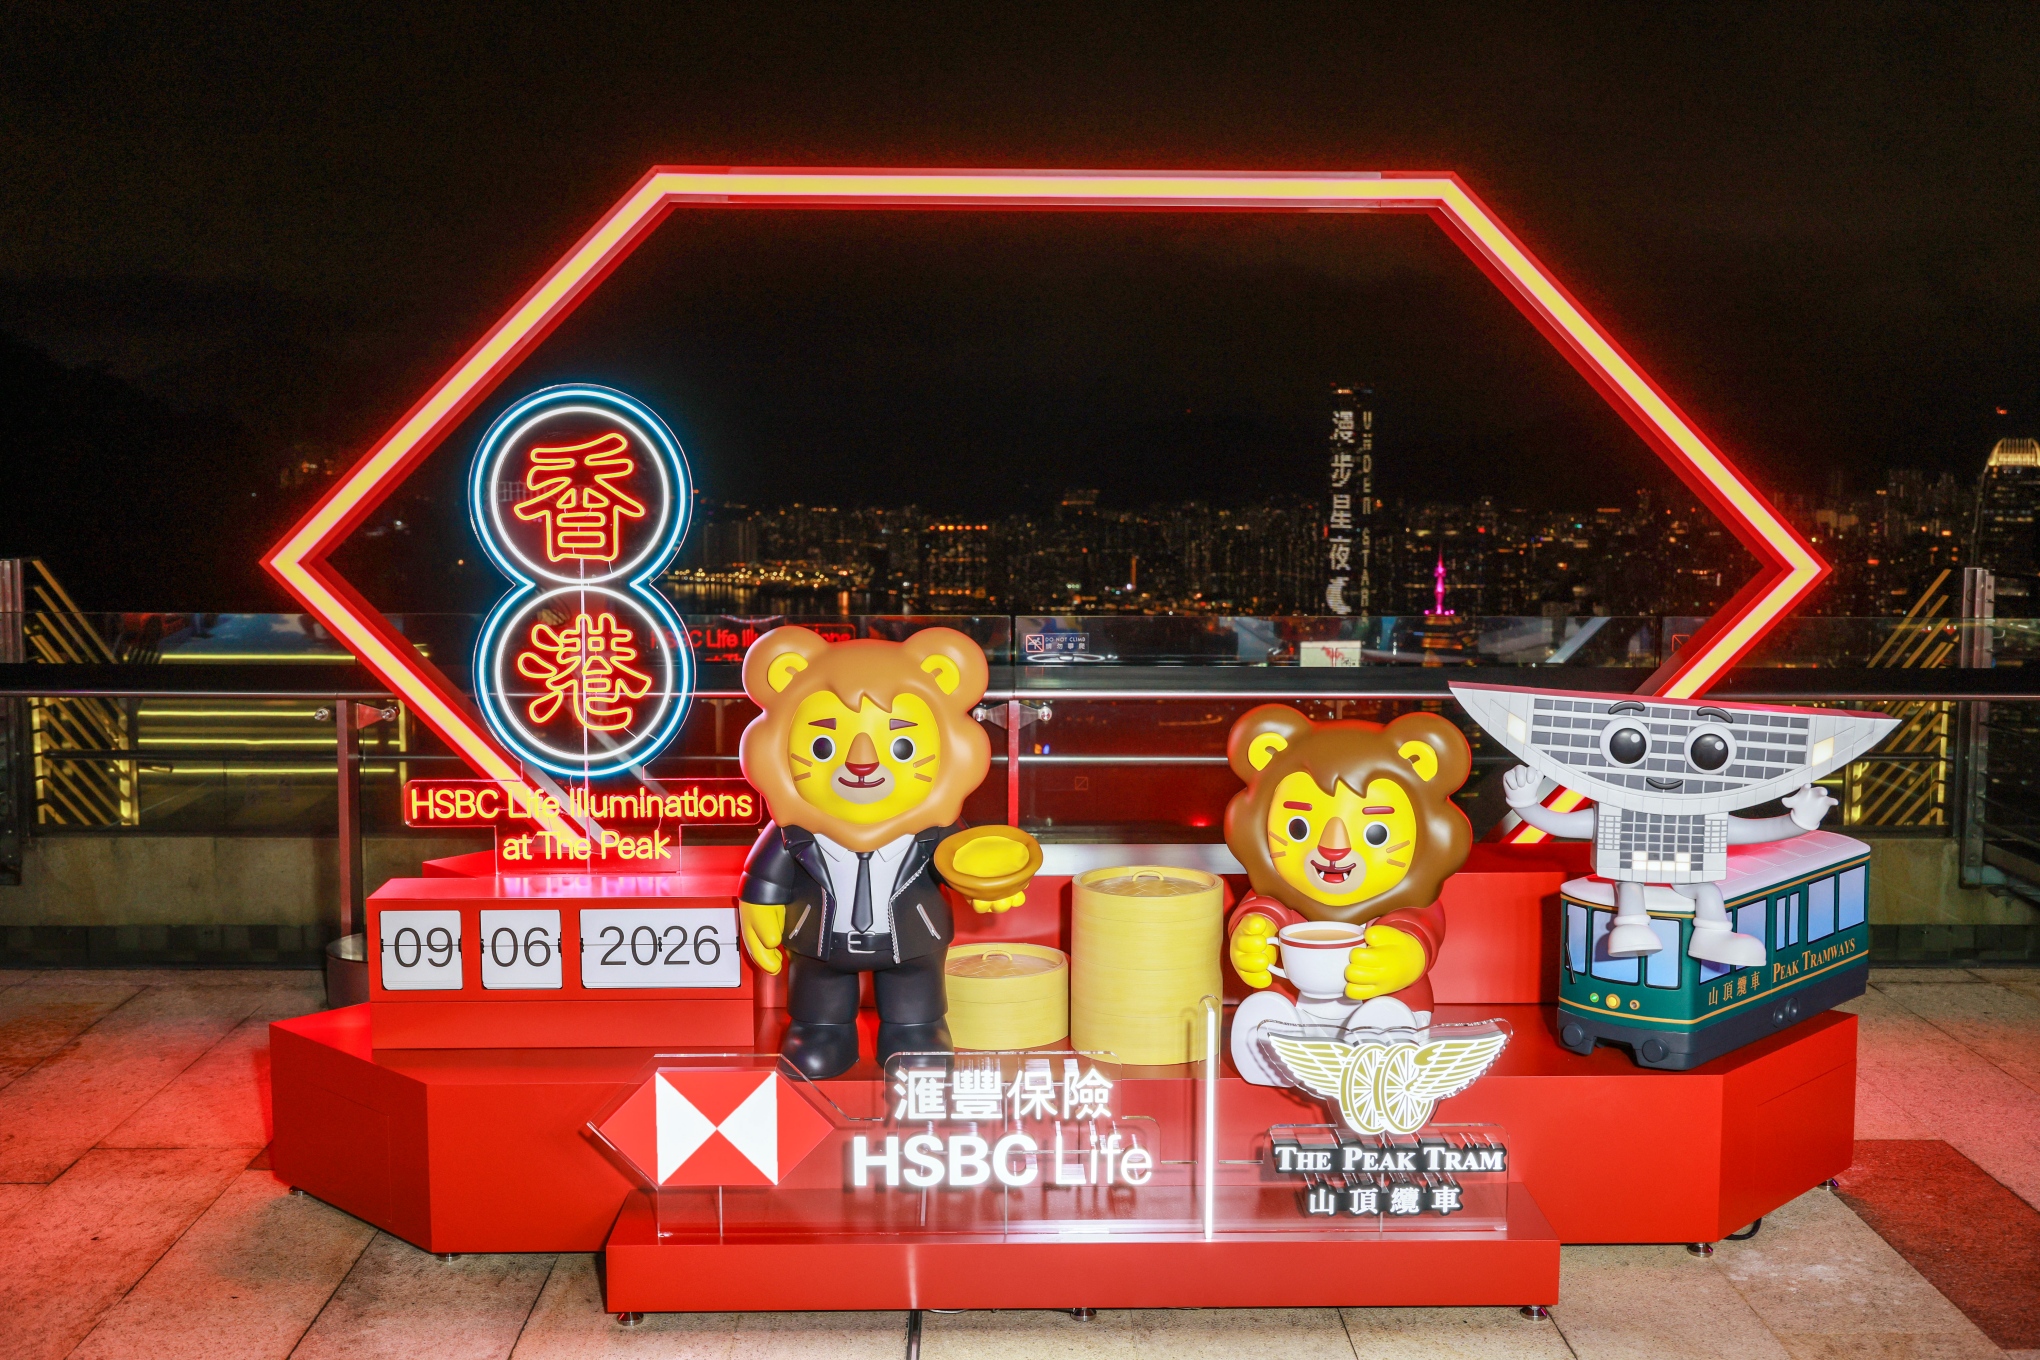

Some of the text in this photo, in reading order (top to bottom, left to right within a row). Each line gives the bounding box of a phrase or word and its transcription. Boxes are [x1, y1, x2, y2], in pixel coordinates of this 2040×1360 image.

[514, 432, 652, 731] 香港
[410, 786, 753, 819] HSBC Life Illuminations
[502, 829, 672, 861] at The Peak
[393, 924, 722, 968] 09 06 2026
[1772, 937, 1857, 983] PEAK TRAMWAYS
[1708, 970, 1761, 1006] 山頂纜車
[852, 1133, 1152, 1187] HSBC Life
[1308, 1186, 1461, 1215] 山頂纜車
